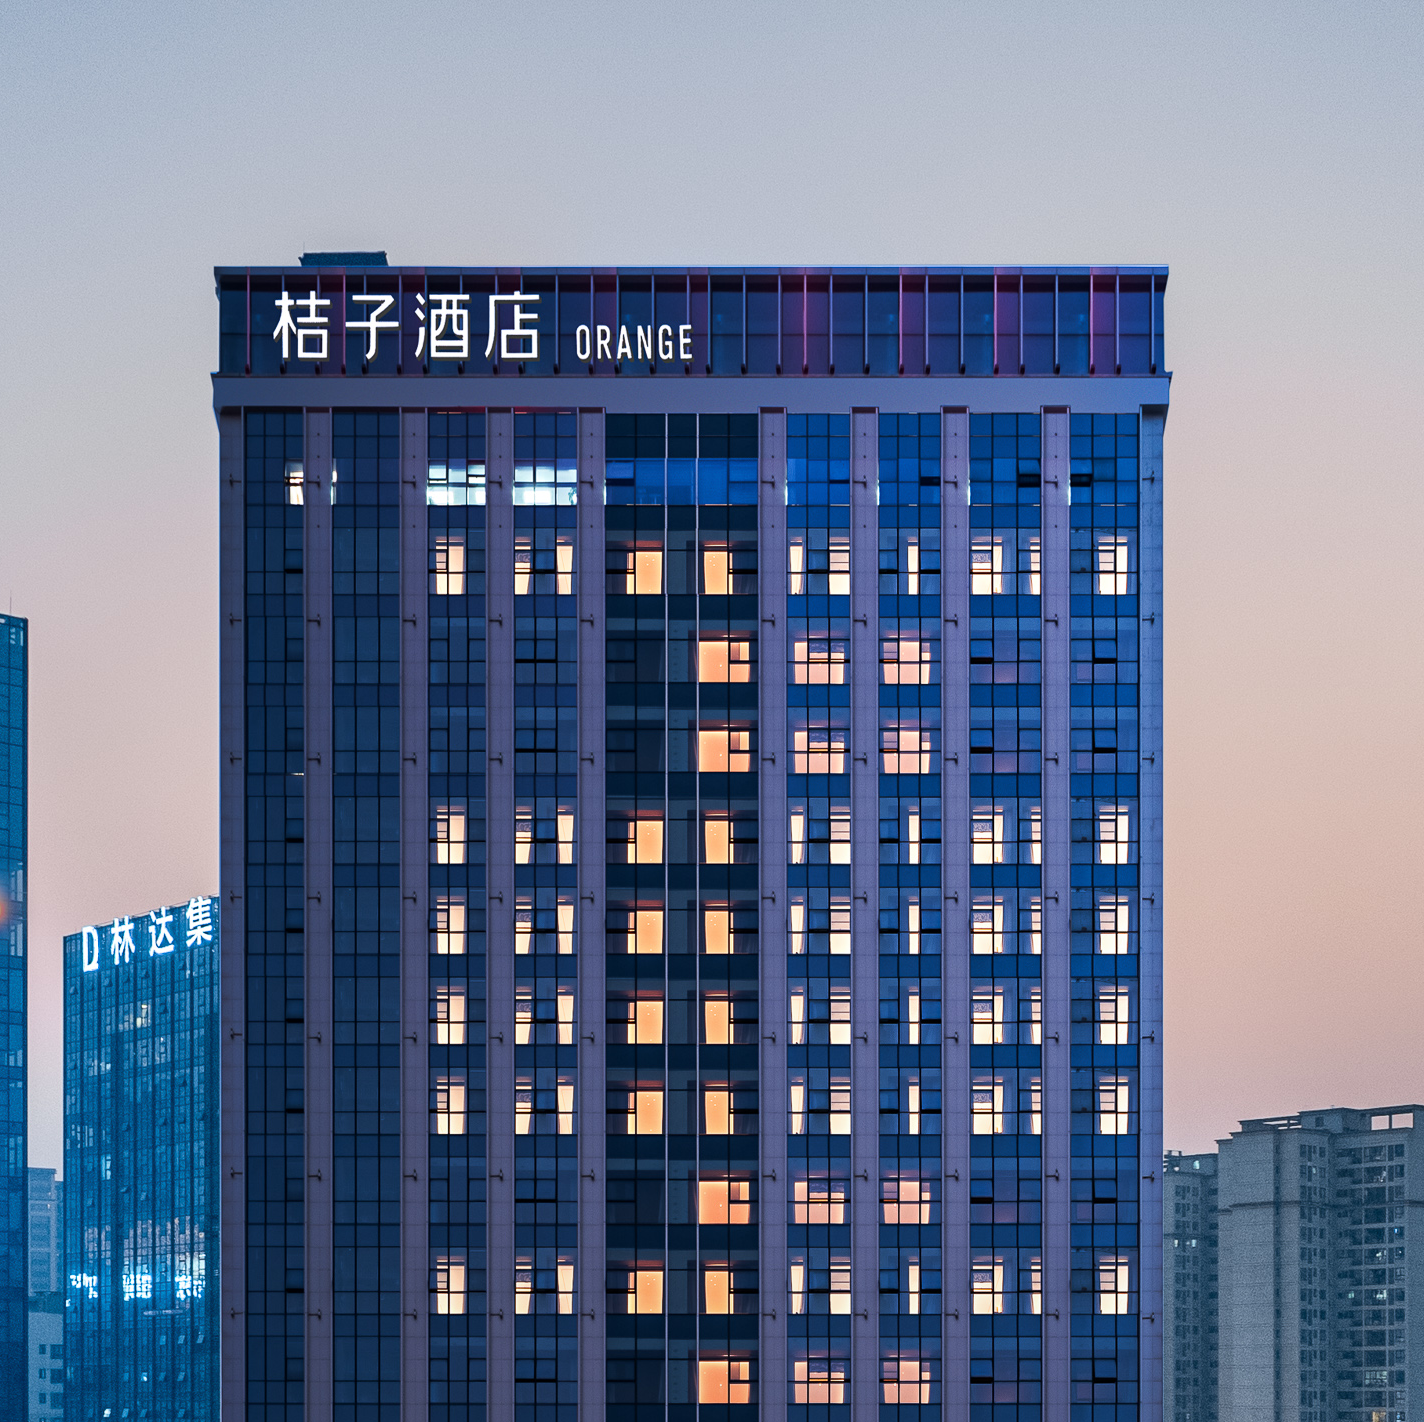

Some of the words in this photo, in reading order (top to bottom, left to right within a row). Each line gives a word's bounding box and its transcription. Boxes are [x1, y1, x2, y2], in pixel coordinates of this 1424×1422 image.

[272, 290, 541, 361] 桔子酒店
[575, 323, 694, 361] ORANGE
